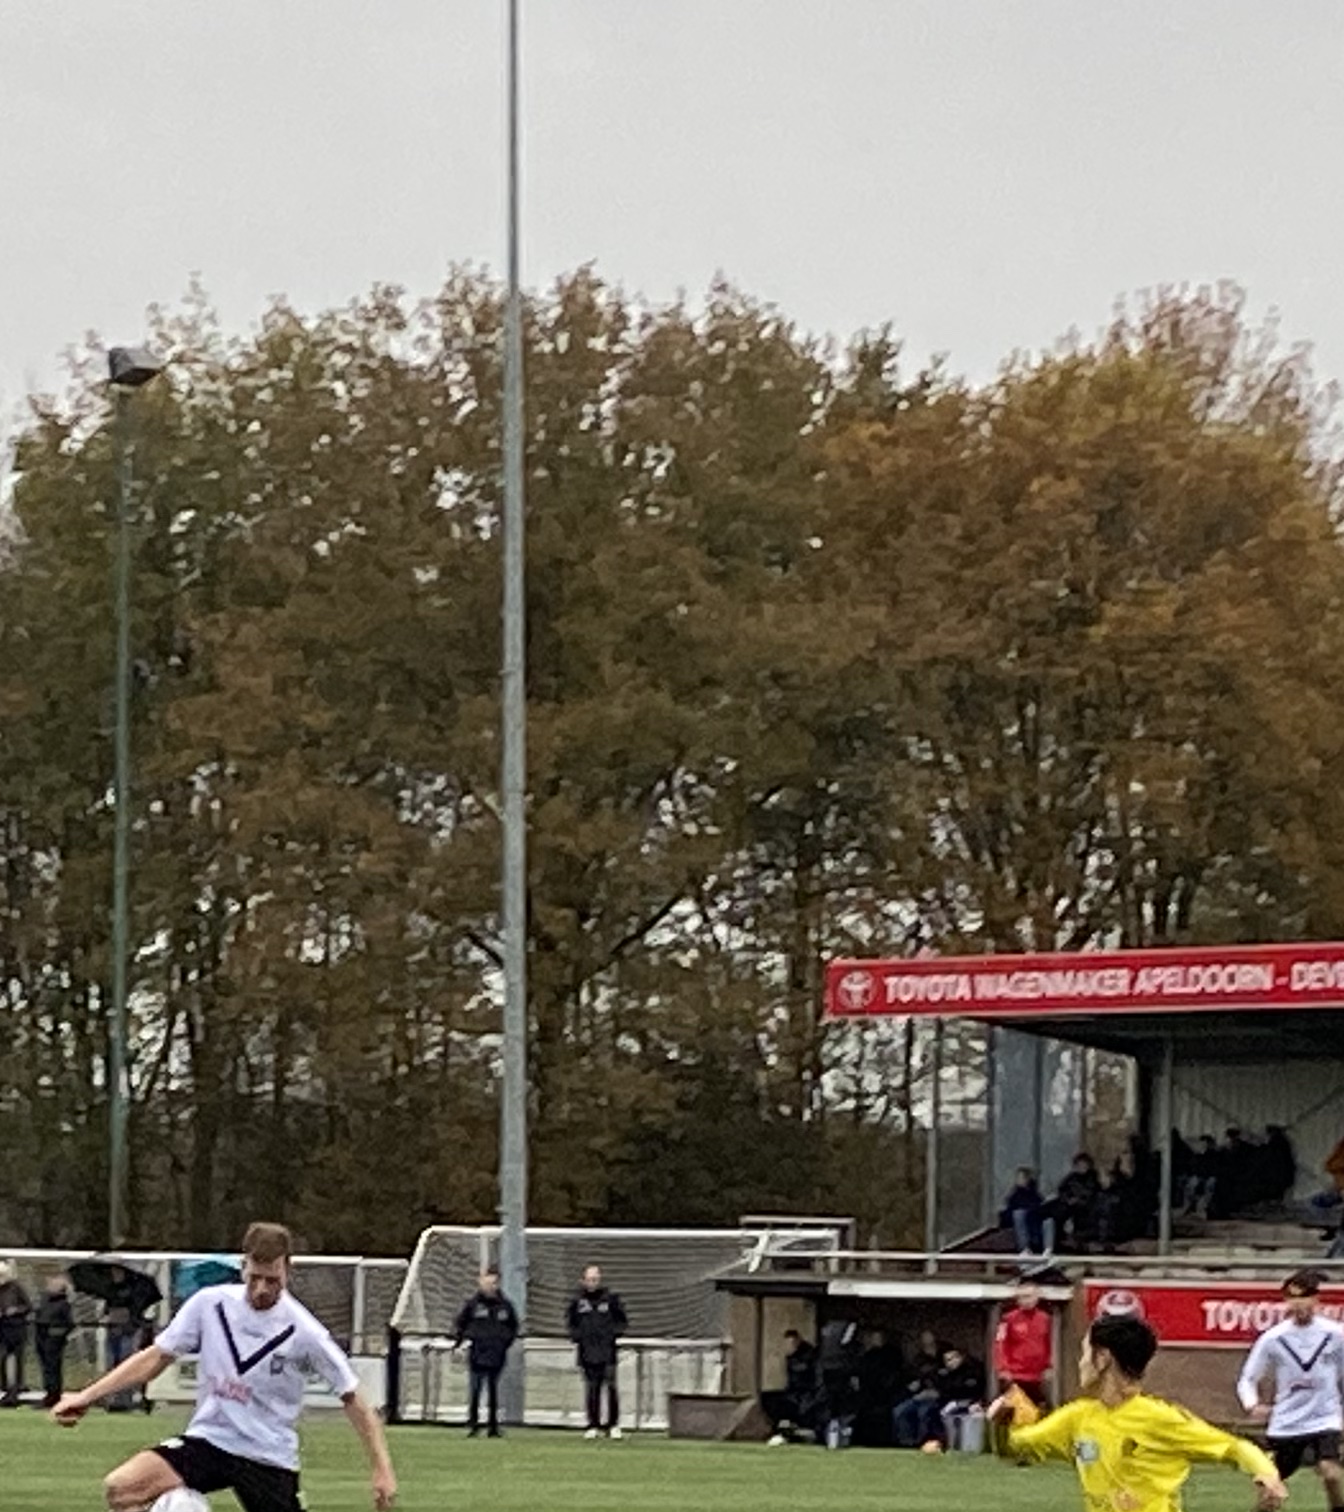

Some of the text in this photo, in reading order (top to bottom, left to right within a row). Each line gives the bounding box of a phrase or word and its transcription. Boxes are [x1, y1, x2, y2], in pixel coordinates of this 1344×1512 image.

[882, 974, 971, 1004] TOYOTA
[972, 968, 1130, 1000] WAGENMAKER
[1133, 963, 1274, 996] APELDOORN
[1200, 1300, 1294, 1332] TOYOT
